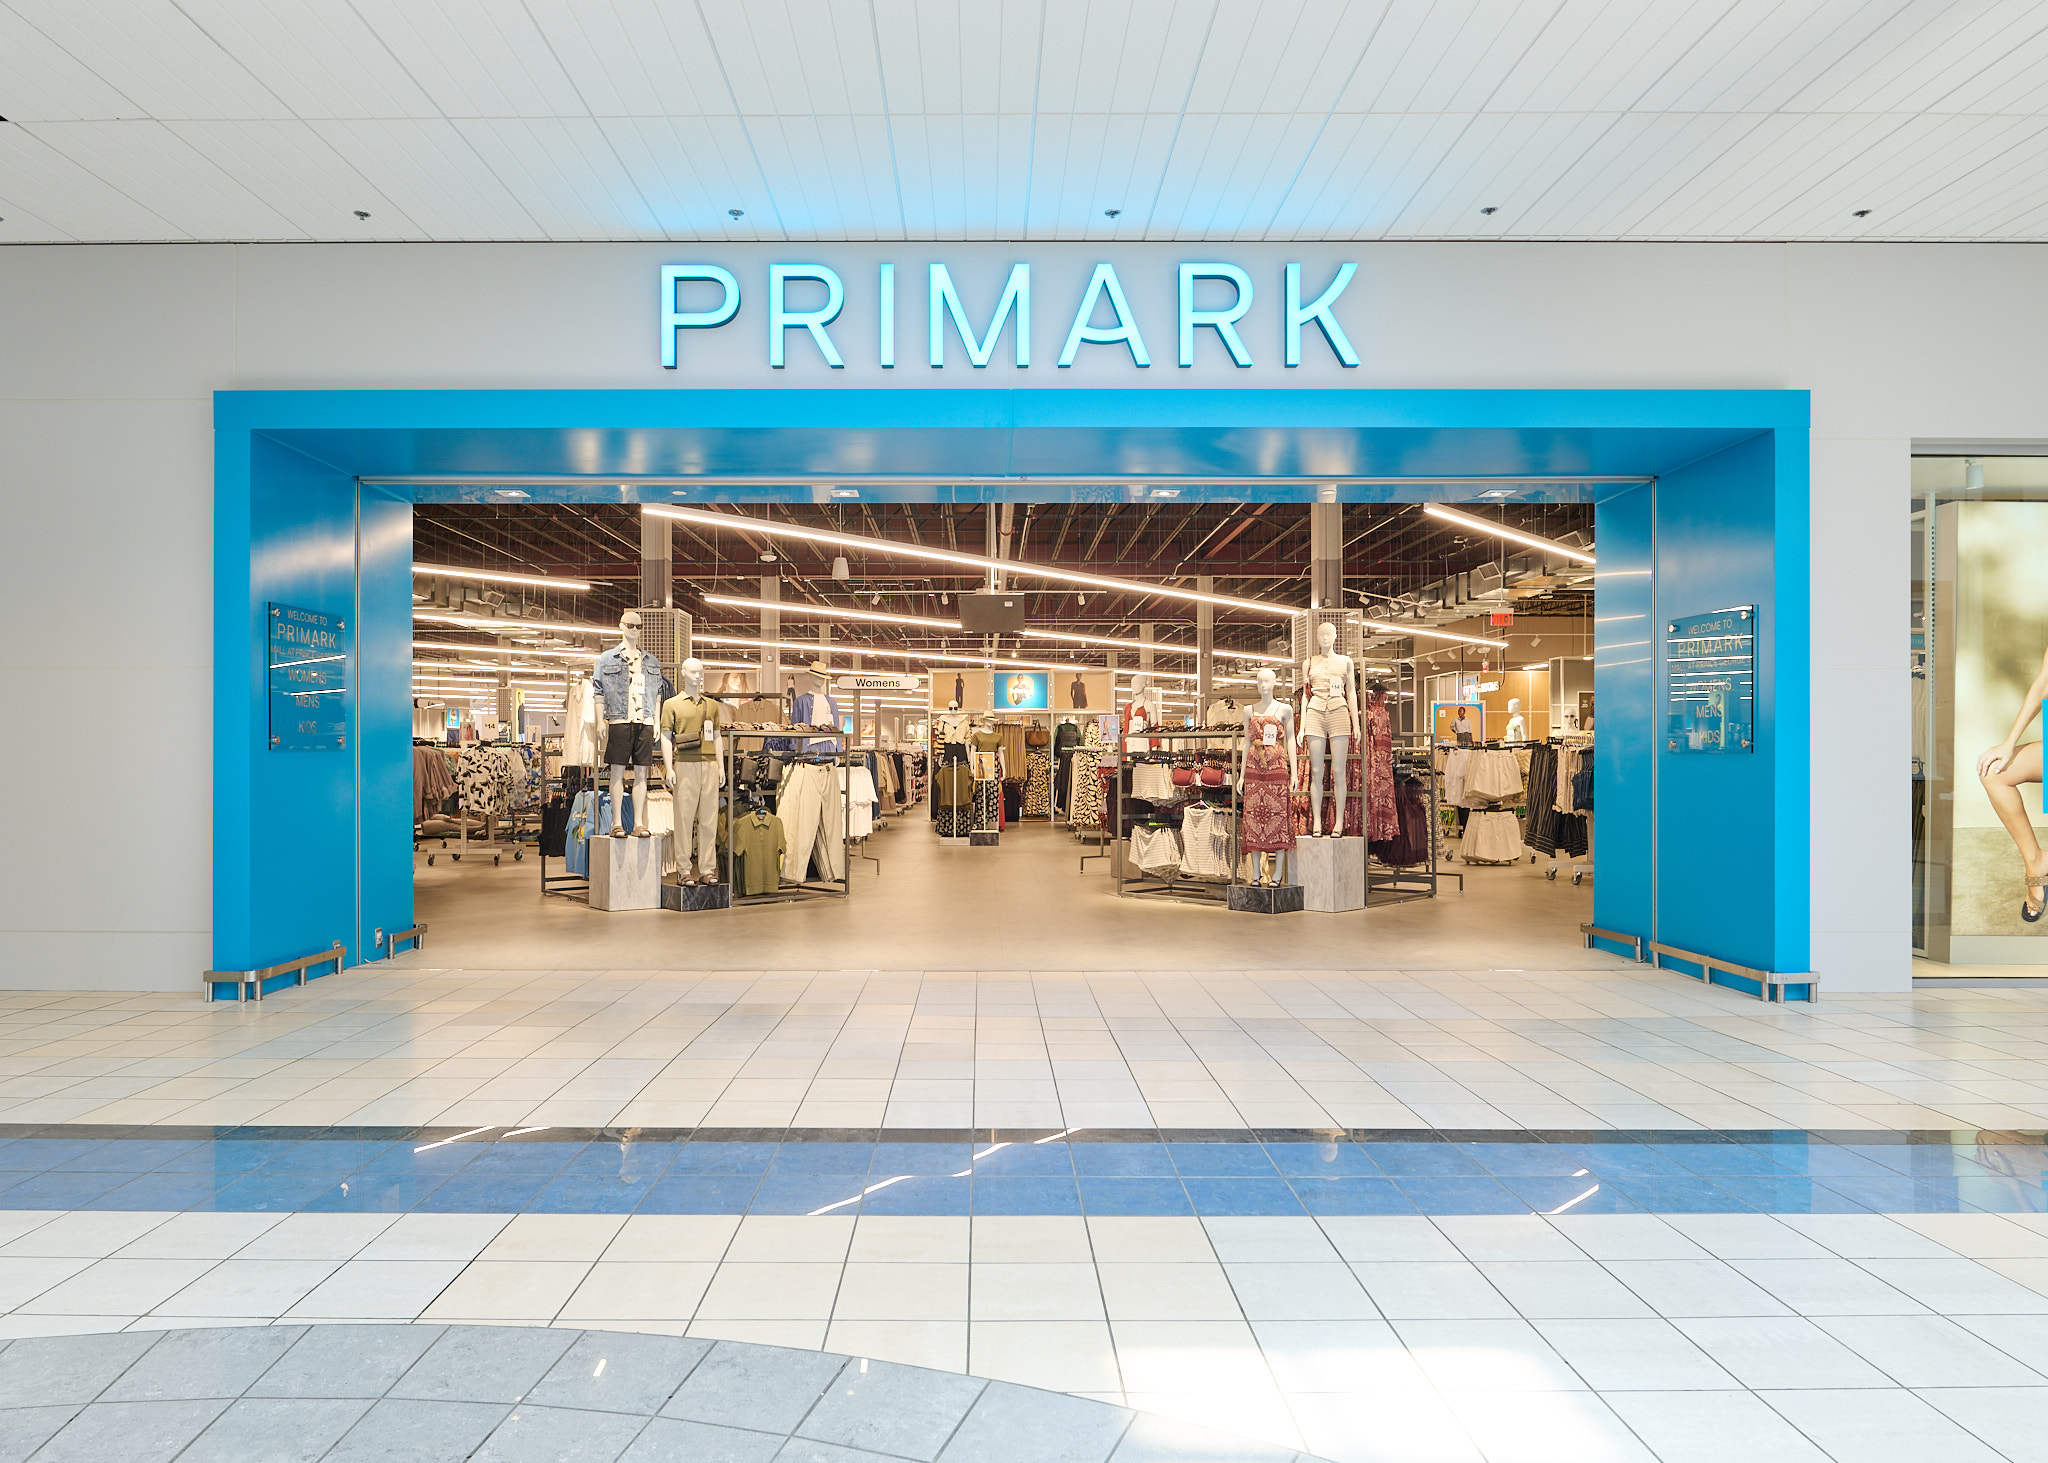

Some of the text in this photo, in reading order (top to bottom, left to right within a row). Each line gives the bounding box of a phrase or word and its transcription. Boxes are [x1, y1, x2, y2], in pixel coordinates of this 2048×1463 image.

[660, 262, 1362, 369] PRIMARK
[287, 610, 328, 626] WELCOME TO
[1688, 619, 1733, 635] WELCOME TO
[277, 623, 336, 648] PRIMARK
[270, 645, 286, 655] MALL
[287, 647, 295, 656] AT
[1678, 633, 1744, 658] PRIMARK
[1671, 663, 1686, 672] MALL
[1687, 661, 1695, 670] AT
[288, 668, 327, 684] WOMENS
[855, 678, 901, 688] Womens
[295, 695, 320, 709] MENS
[1696, 703, 1724, 718] MENS
[298, 720, 317, 733] KIDS
[1699, 730, 1720, 744] KIDS
